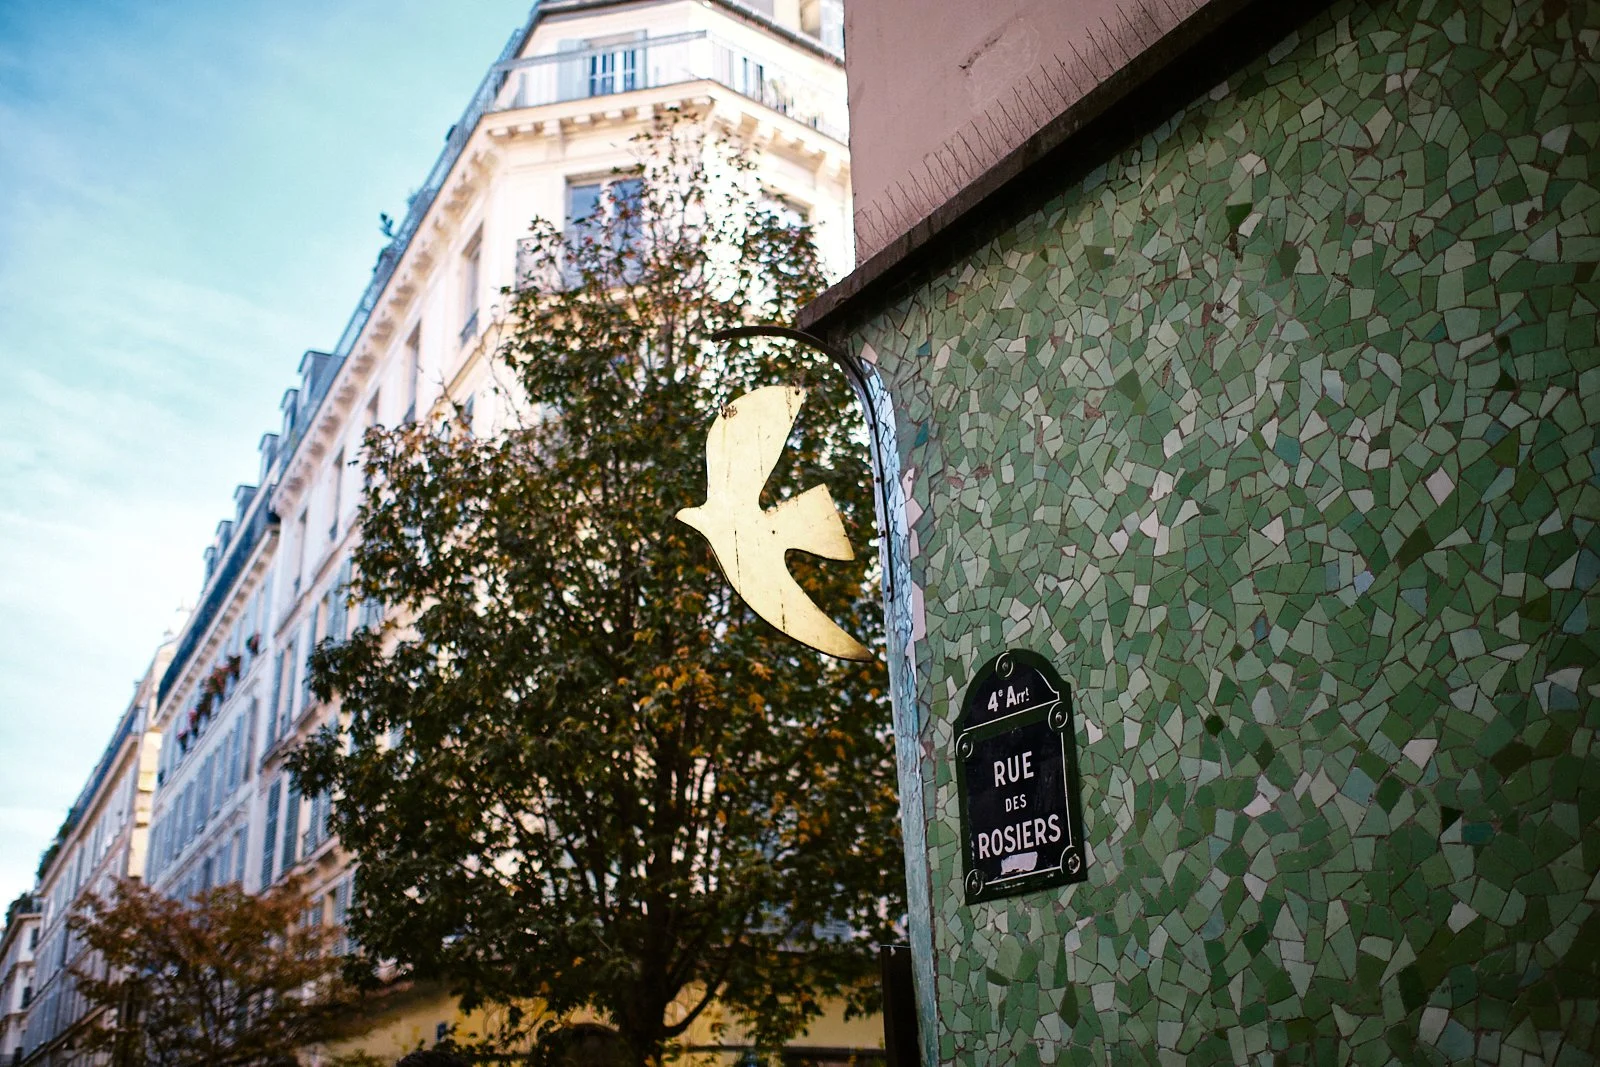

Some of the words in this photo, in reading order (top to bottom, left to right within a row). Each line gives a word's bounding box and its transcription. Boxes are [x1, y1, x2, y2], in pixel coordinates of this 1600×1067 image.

[994, 751, 1034, 787] RUE
[1005, 794, 1027, 812] DES
[978, 814, 1061, 859] ROSIERS
